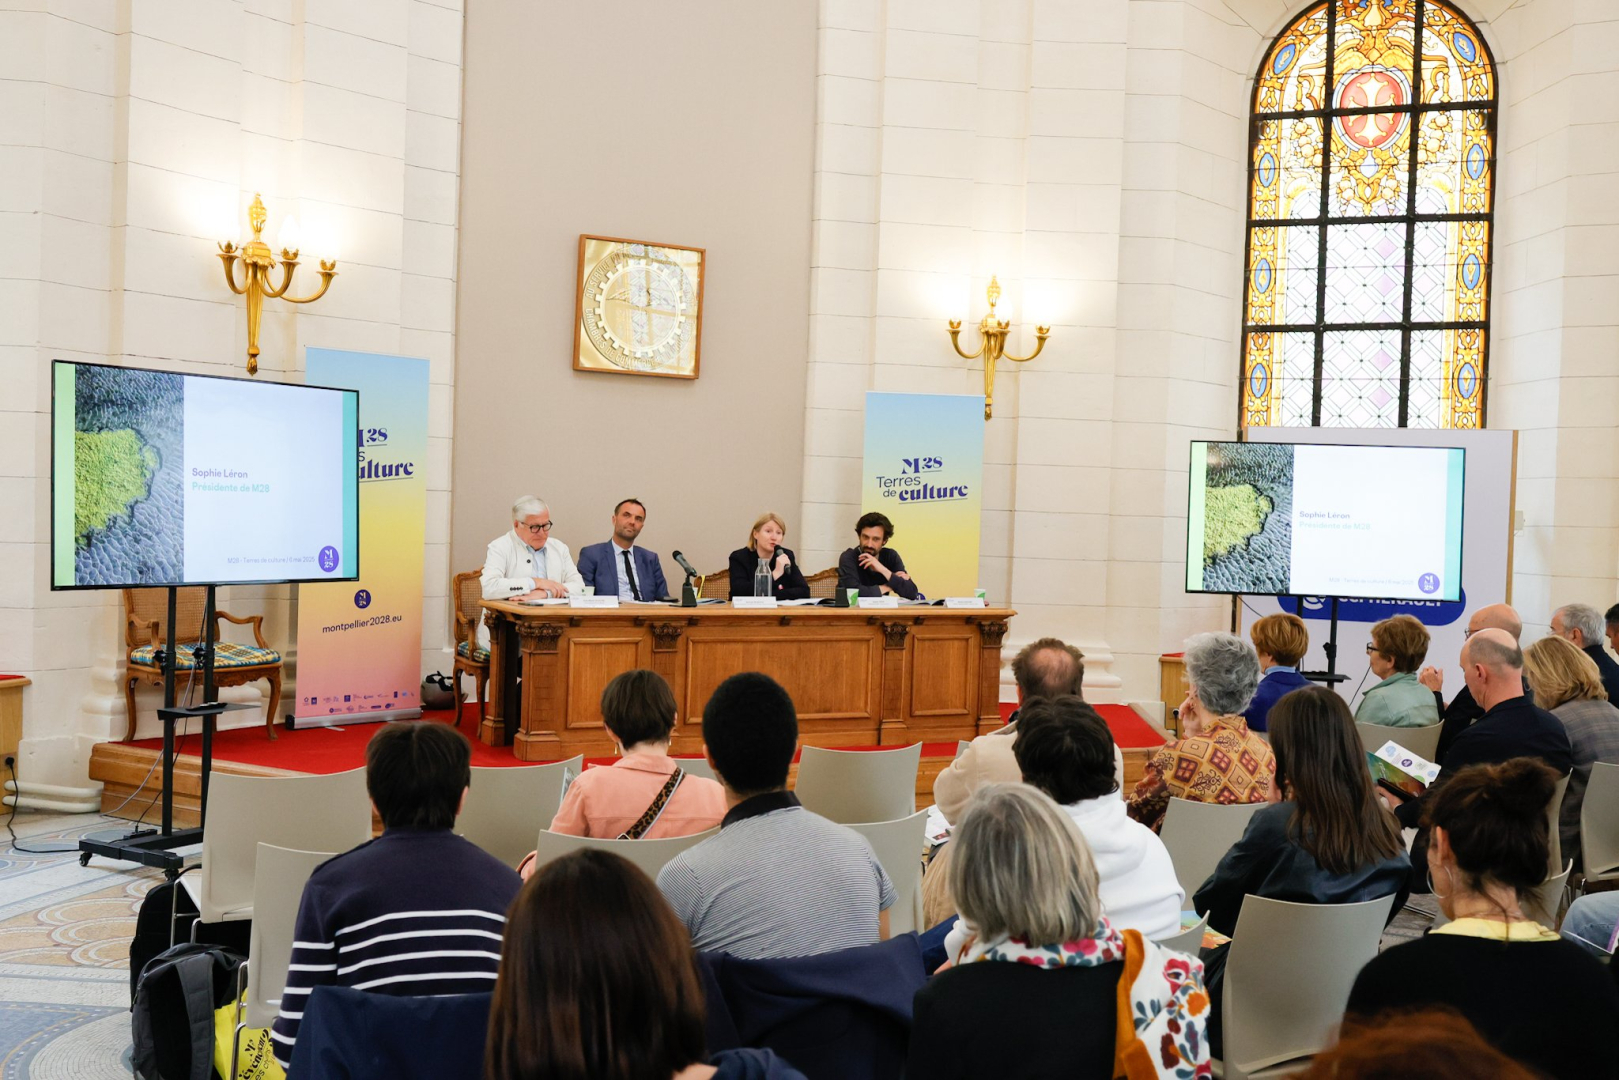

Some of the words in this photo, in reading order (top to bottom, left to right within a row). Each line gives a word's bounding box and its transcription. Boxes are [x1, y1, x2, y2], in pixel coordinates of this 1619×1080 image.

[585, 308, 606, 349] CHAMBRES
[192, 467, 222, 479] Sophie
[223, 468, 248, 479] Léron
[358, 458, 414, 480] ulture
[192, 481, 238, 492] Présidente
[239, 483, 251, 493] de
[252, 483, 270, 493] M28
[876, 475, 921, 488] Terres
[882, 488, 897, 498] de
[898, 482, 968, 502] culture
[1299, 510, 1326, 519] Sophie
[1327, 511, 1350, 519] Léron
[1299, 520, 1341, 530] Présidente
[1342, 522, 1352, 530] de
[1353, 523, 1371, 531] M28
[322, 614, 402, 634] montpellier2028.eu
